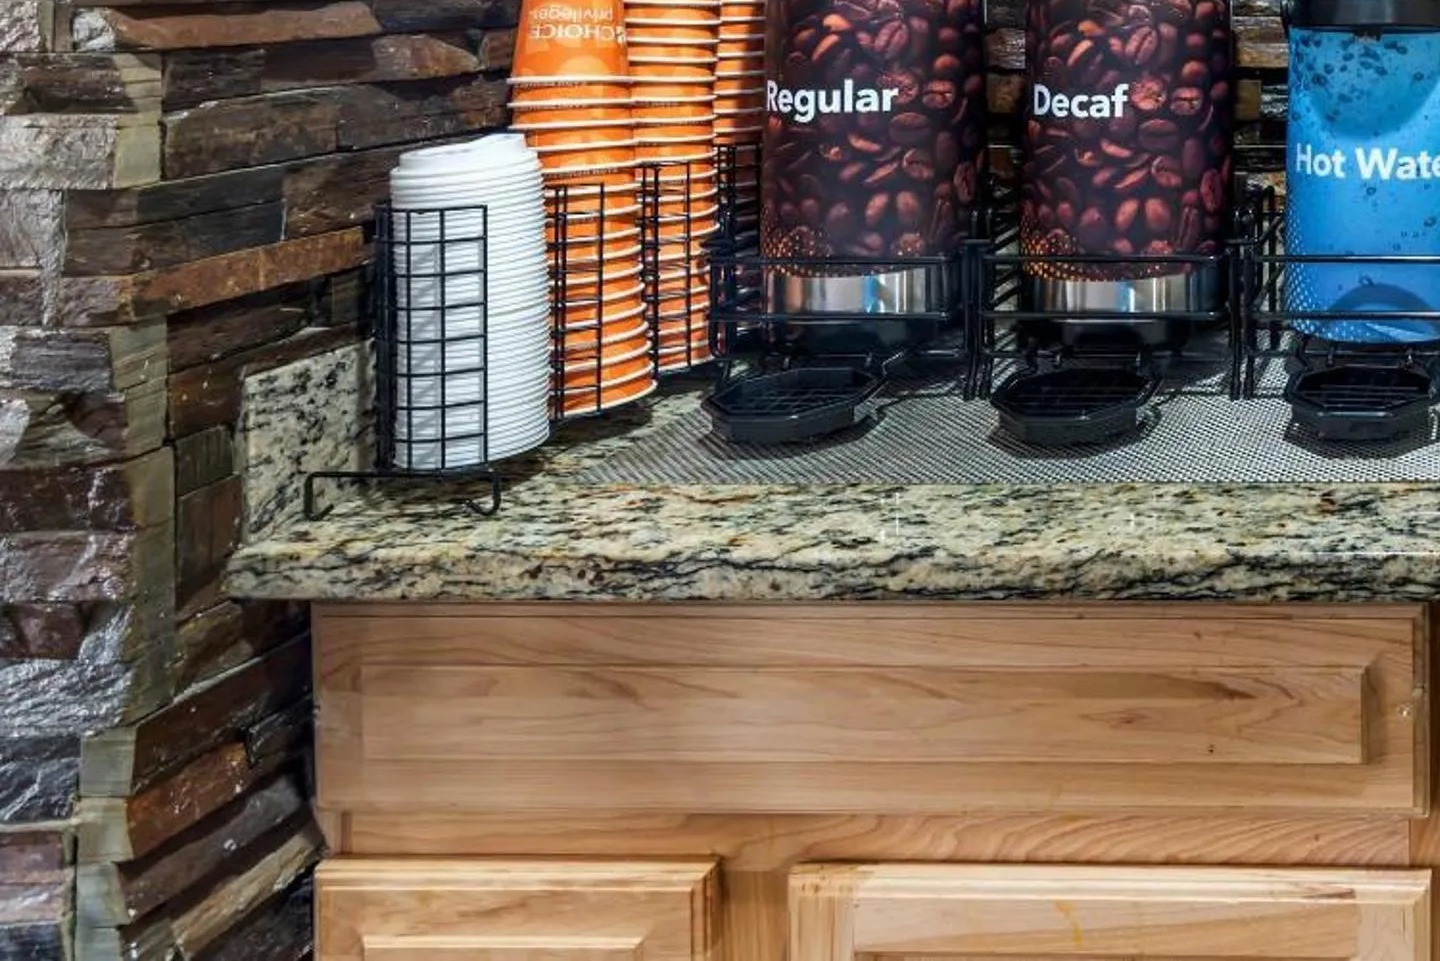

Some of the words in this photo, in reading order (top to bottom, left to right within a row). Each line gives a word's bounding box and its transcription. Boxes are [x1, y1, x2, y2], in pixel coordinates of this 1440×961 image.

[766, 79, 899, 123] Regular
[1033, 84, 1129, 118] Decaf
[1296, 143, 1346, 178] Hot
